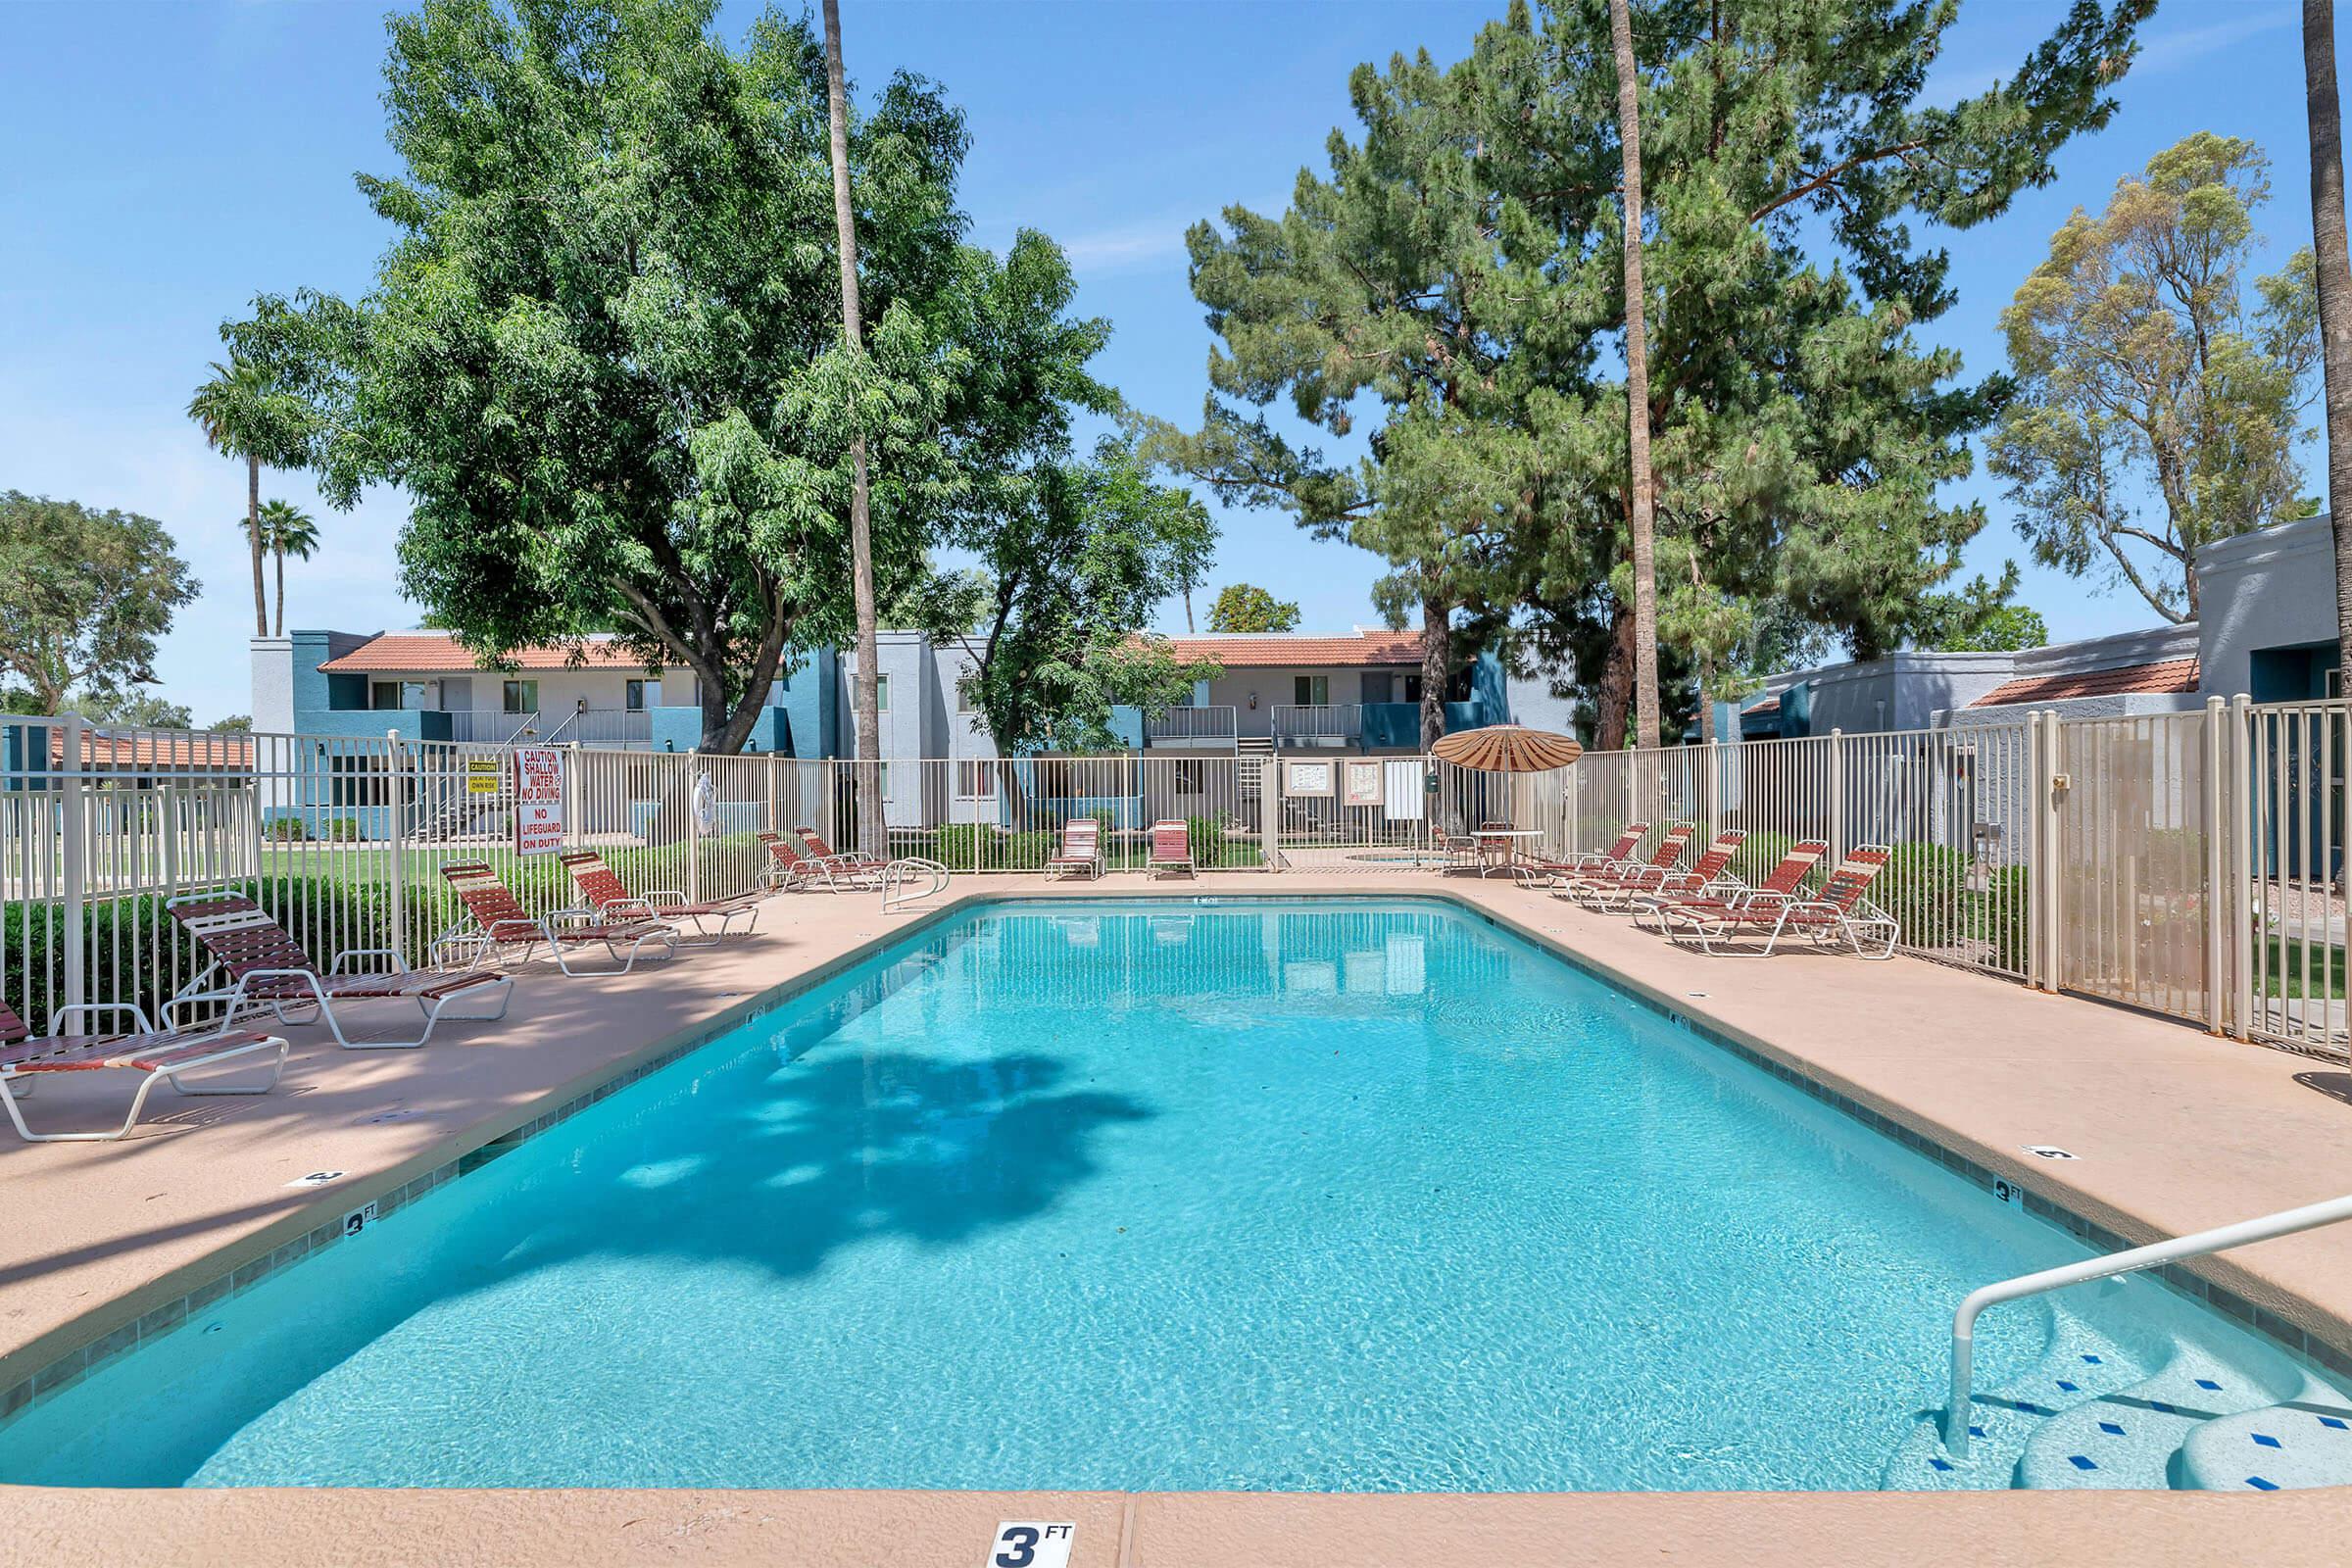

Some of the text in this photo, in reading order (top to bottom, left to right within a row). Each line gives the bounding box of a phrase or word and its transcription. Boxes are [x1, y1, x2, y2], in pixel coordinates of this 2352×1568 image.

[524, 751, 557, 762] CAUTION
[524, 763, 559, 774] SHALLOW
[530, 775, 554, 786] WATER
[522, 787, 560, 800] NO DIVING
[535, 808, 547, 819] NO
[522, 822, 562, 835] LIFEGUARD
[523, 838, 561, 850] ON DUTY
[1995, 1180, 2021, 1202] 3 FT
[365, 1203, 376, 1218] FT
[996, 1525, 1072, 1568] 3 FT
